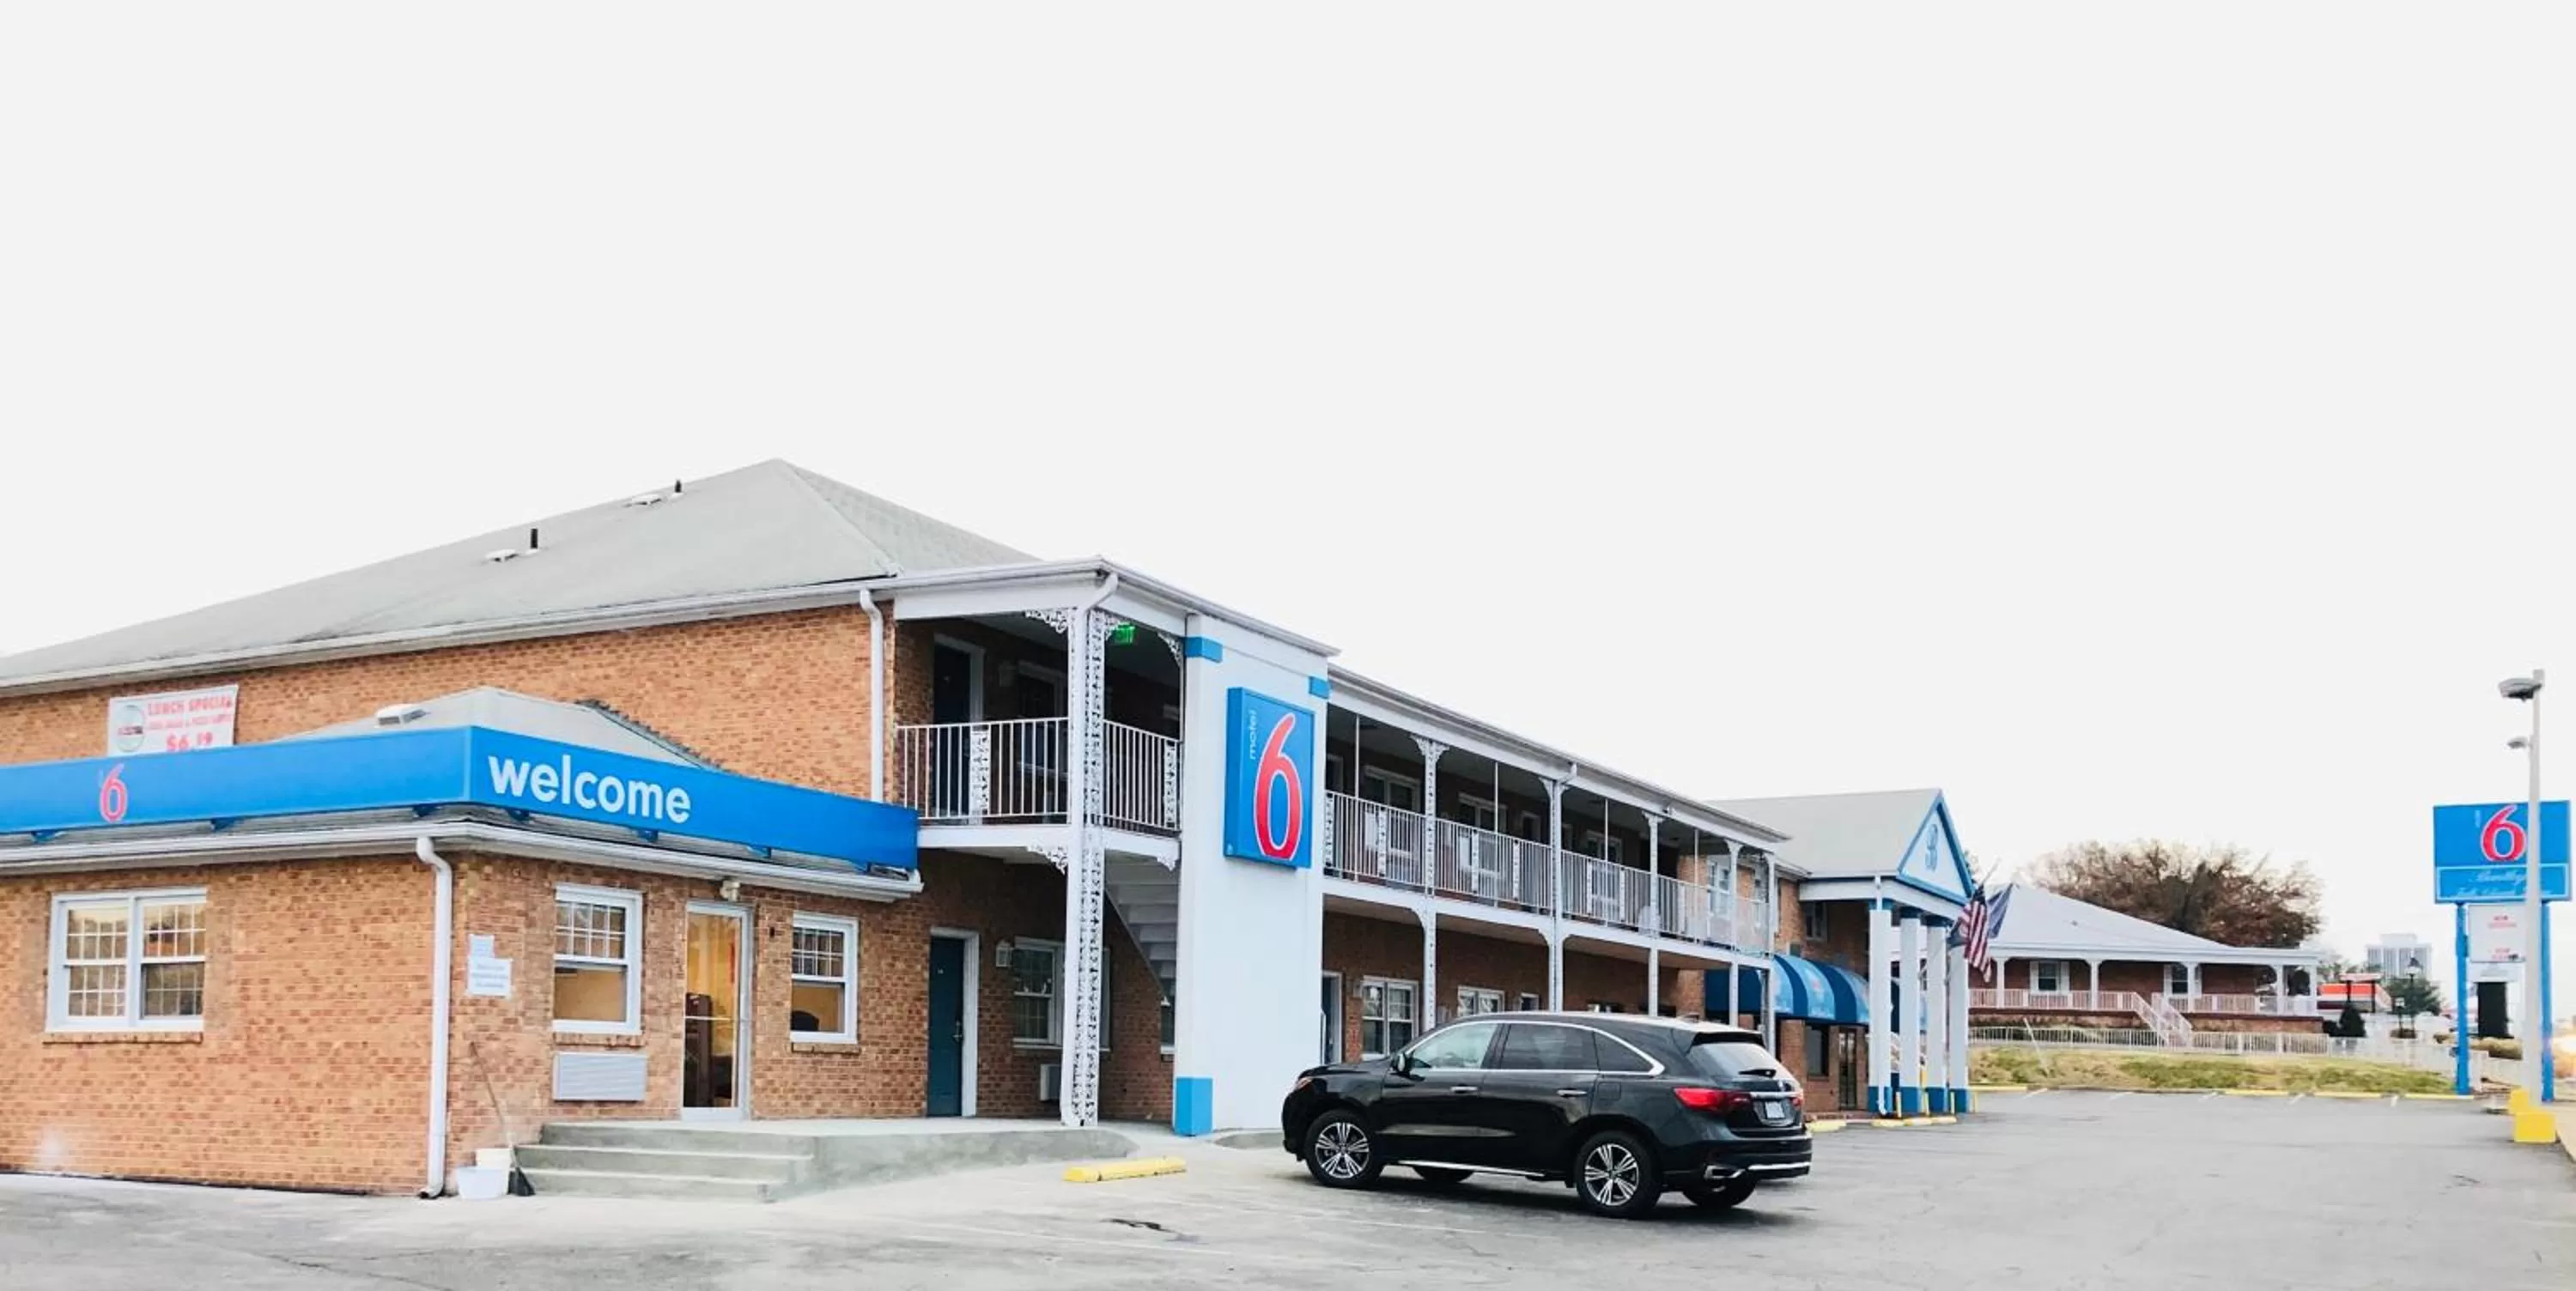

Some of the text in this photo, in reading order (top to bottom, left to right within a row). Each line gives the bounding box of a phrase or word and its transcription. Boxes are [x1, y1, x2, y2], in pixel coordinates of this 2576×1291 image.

[100, 763, 128, 822] 6
[488, 755, 691, 824] welcome
[1254, 712, 1303, 861] 6
[2481, 804, 2526, 862] 6
